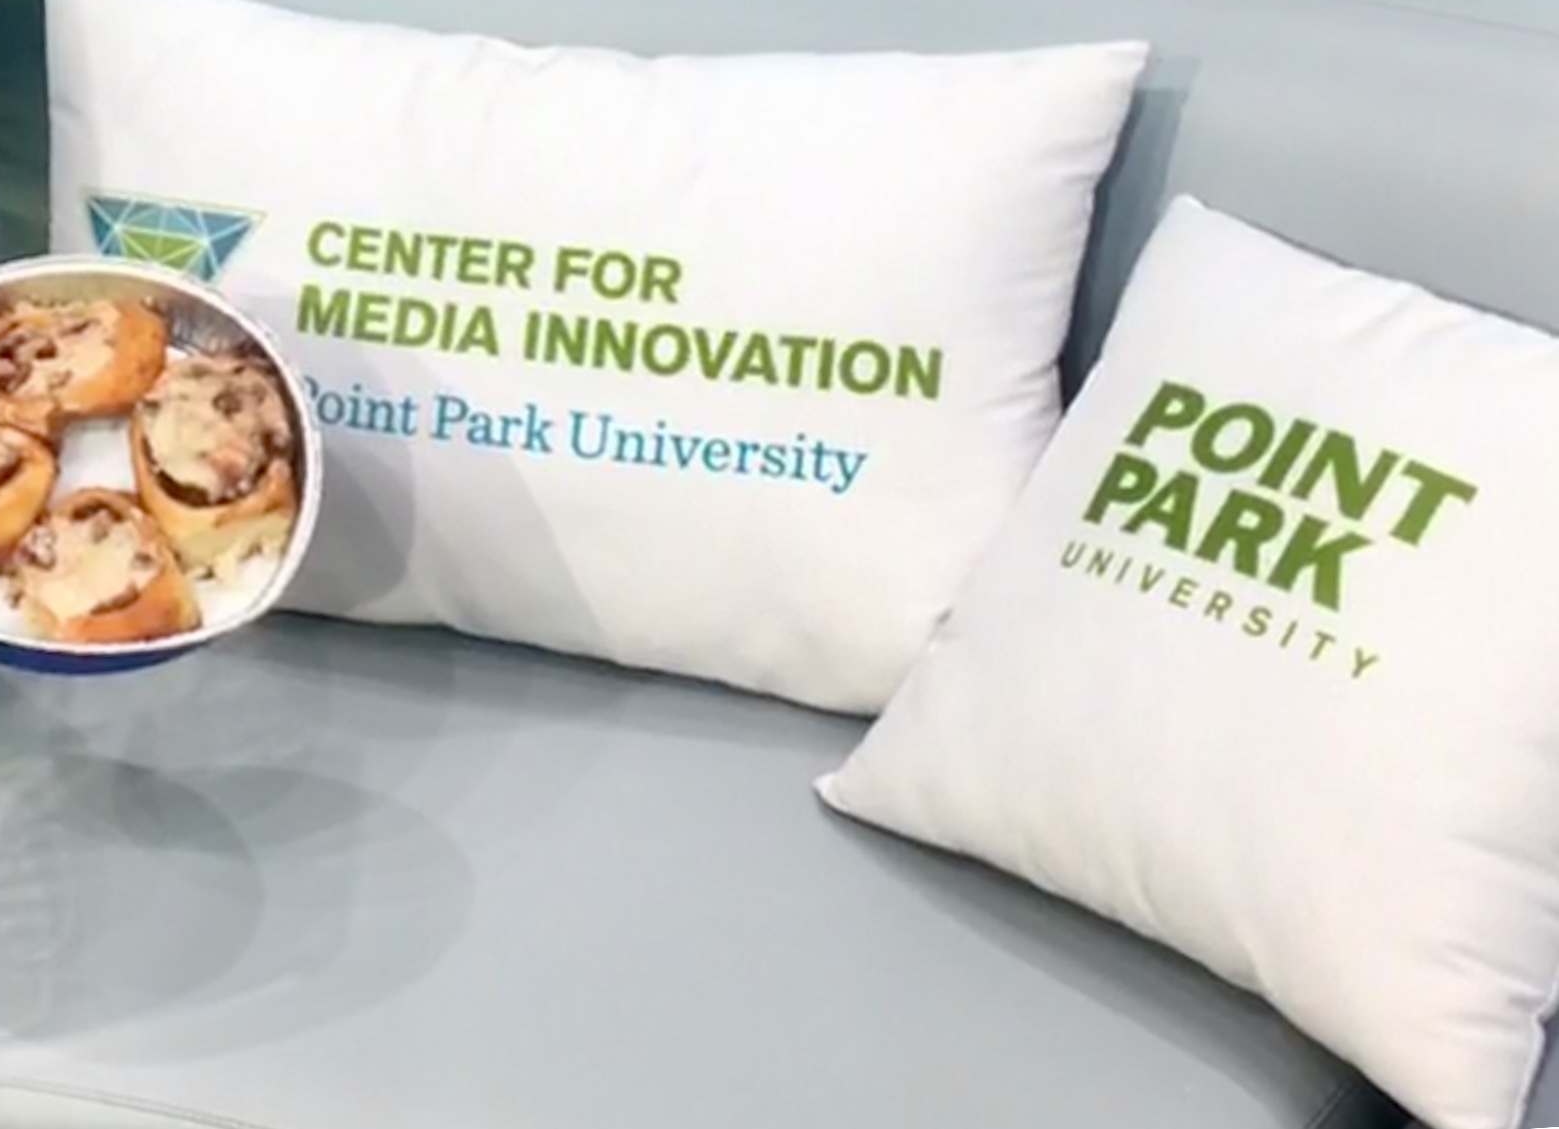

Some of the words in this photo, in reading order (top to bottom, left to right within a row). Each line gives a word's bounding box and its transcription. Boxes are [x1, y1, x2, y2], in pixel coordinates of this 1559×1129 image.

[307, 221, 536, 289] CENTER
[554, 246, 683, 303] FOR
[296, 284, 501, 356] MEDIA
[523, 310, 944, 399] INNOVATION
[430, 394, 553, 452] Park
[568, 410, 868, 493] University
[1124, 380, 1479, 547] POINT
[1082, 451, 1374, 612] PARK
[1060, 541, 1378, 679] UNIVERSITY
